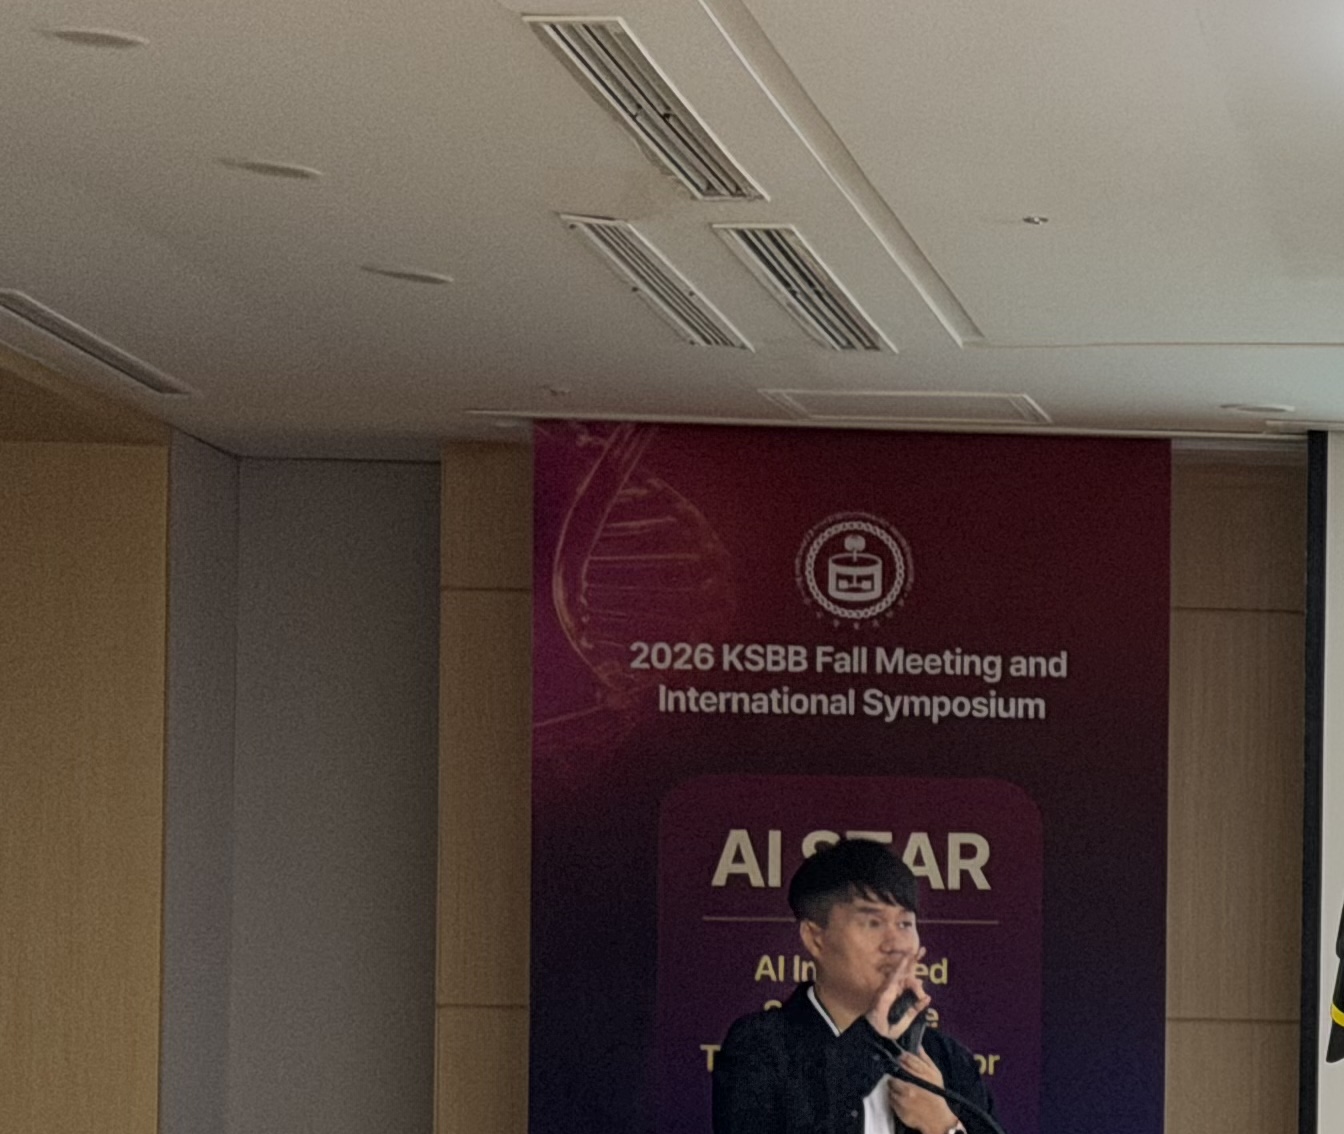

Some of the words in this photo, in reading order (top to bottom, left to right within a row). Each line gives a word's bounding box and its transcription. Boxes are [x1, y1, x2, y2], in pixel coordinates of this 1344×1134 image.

[629, 642, 714, 671] 2026
[721, 644, 808, 672] KSBB
[815, 645, 868, 674] Fall
[875, 647, 1002, 682] Meeting
[1009, 650, 1068, 678] and
[658, 684, 855, 716] International
[862, 688, 1047, 724] Symposium
[712, 829, 782, 888] AI
[802, 830, 991, 890] AR
[755, 955, 784, 982] AI
